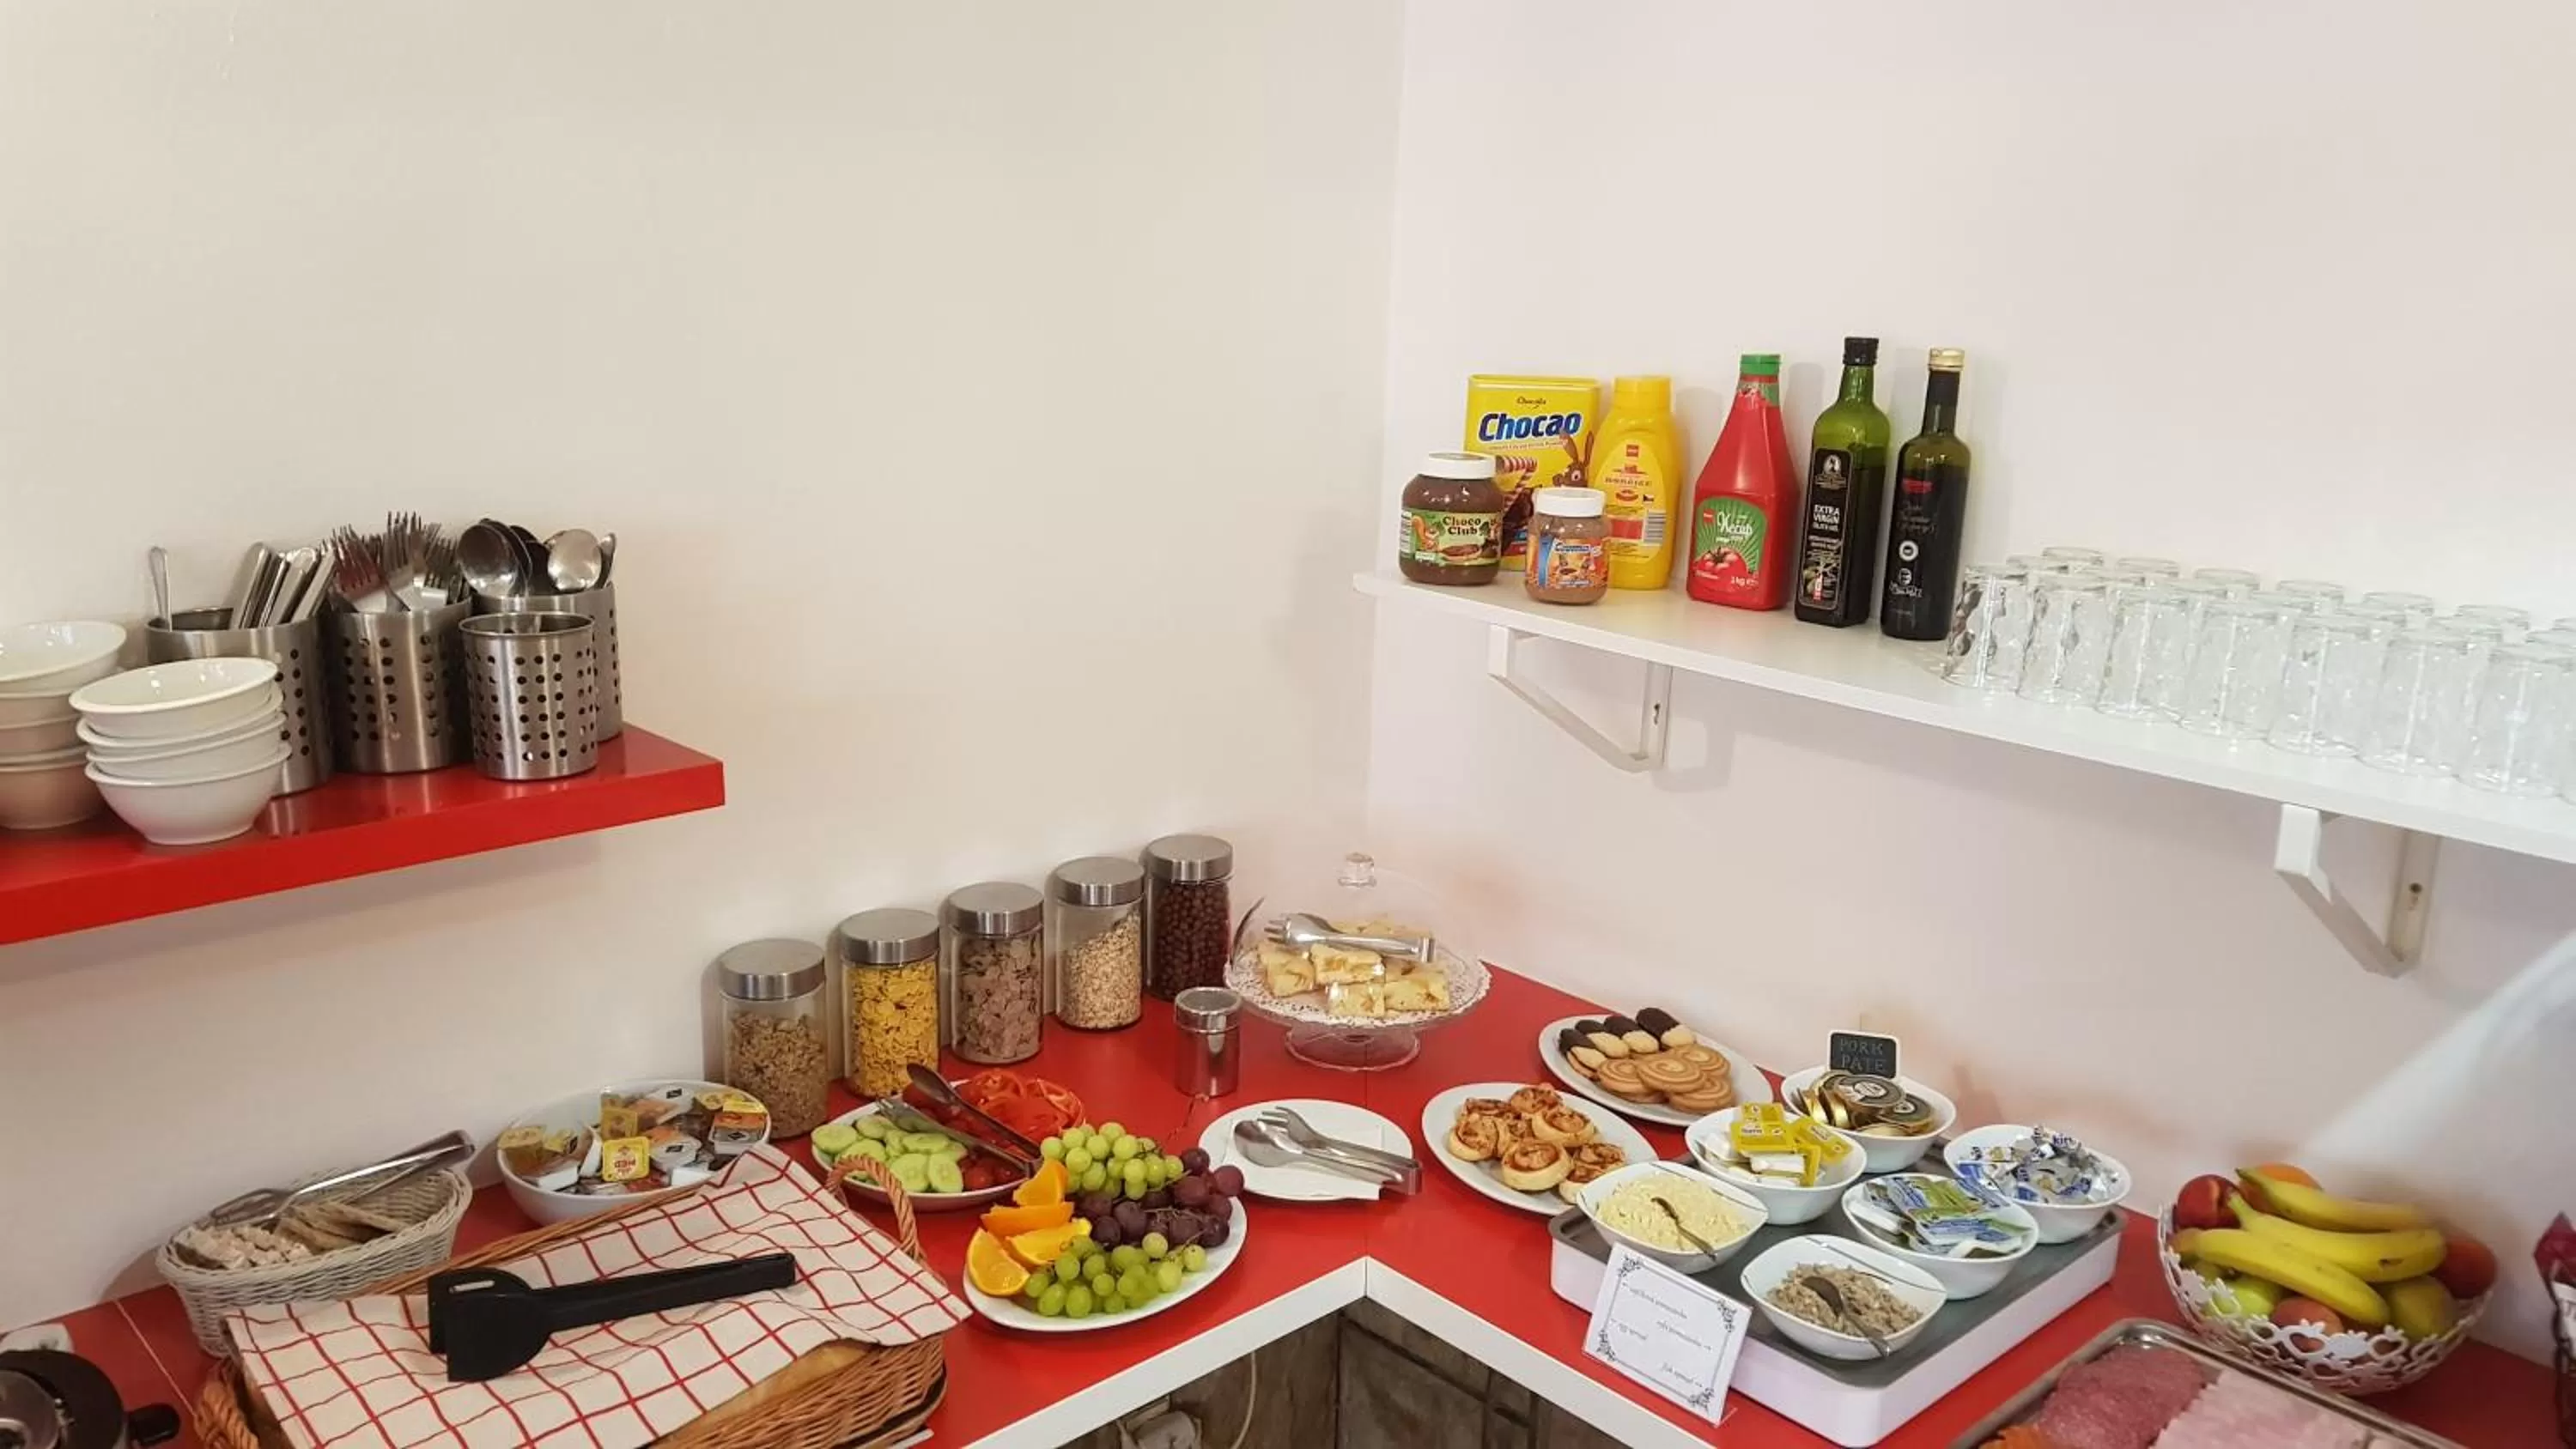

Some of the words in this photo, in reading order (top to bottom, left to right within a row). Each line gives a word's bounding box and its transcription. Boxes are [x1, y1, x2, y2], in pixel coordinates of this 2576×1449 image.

[1478, 412, 1583, 442] Chocao
[1814, 504, 1840, 517] EXTRA
[1443, 516, 1481, 526] Choco
[1447, 526, 1478, 535] Club
[1840, 1038, 1883, 1056] PORK
[1842, 1053, 1886, 1072] PATE
